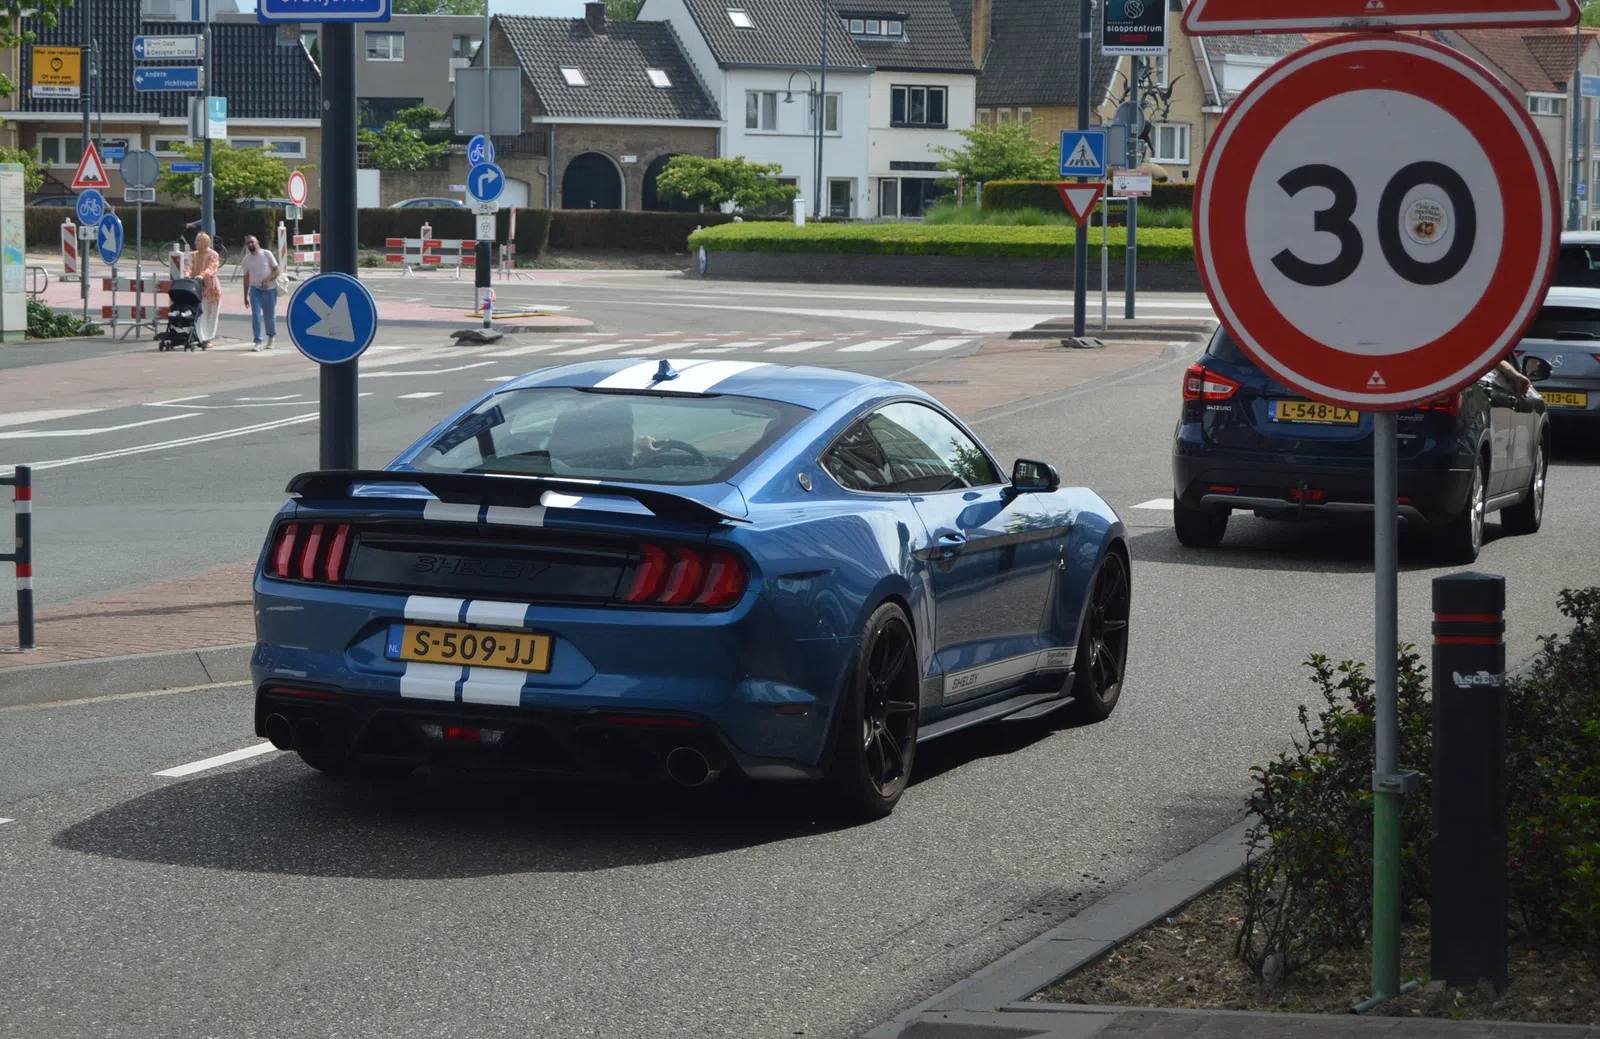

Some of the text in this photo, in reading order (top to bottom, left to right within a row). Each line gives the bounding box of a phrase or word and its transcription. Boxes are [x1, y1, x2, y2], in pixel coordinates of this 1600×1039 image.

[164, 80, 198, 88] richtingen
[1270, 161, 1476, 287] 30
[1542, 393, 1579, 404] -113-GL
[1282, 403, 1352, 420] L-548-LX
[413, 555, 550, 581] SHELBY
[388, 644, 399, 653] NL
[413, 630, 536, 665] S-509-JJ
[952, 673, 979, 689] SHELBY
